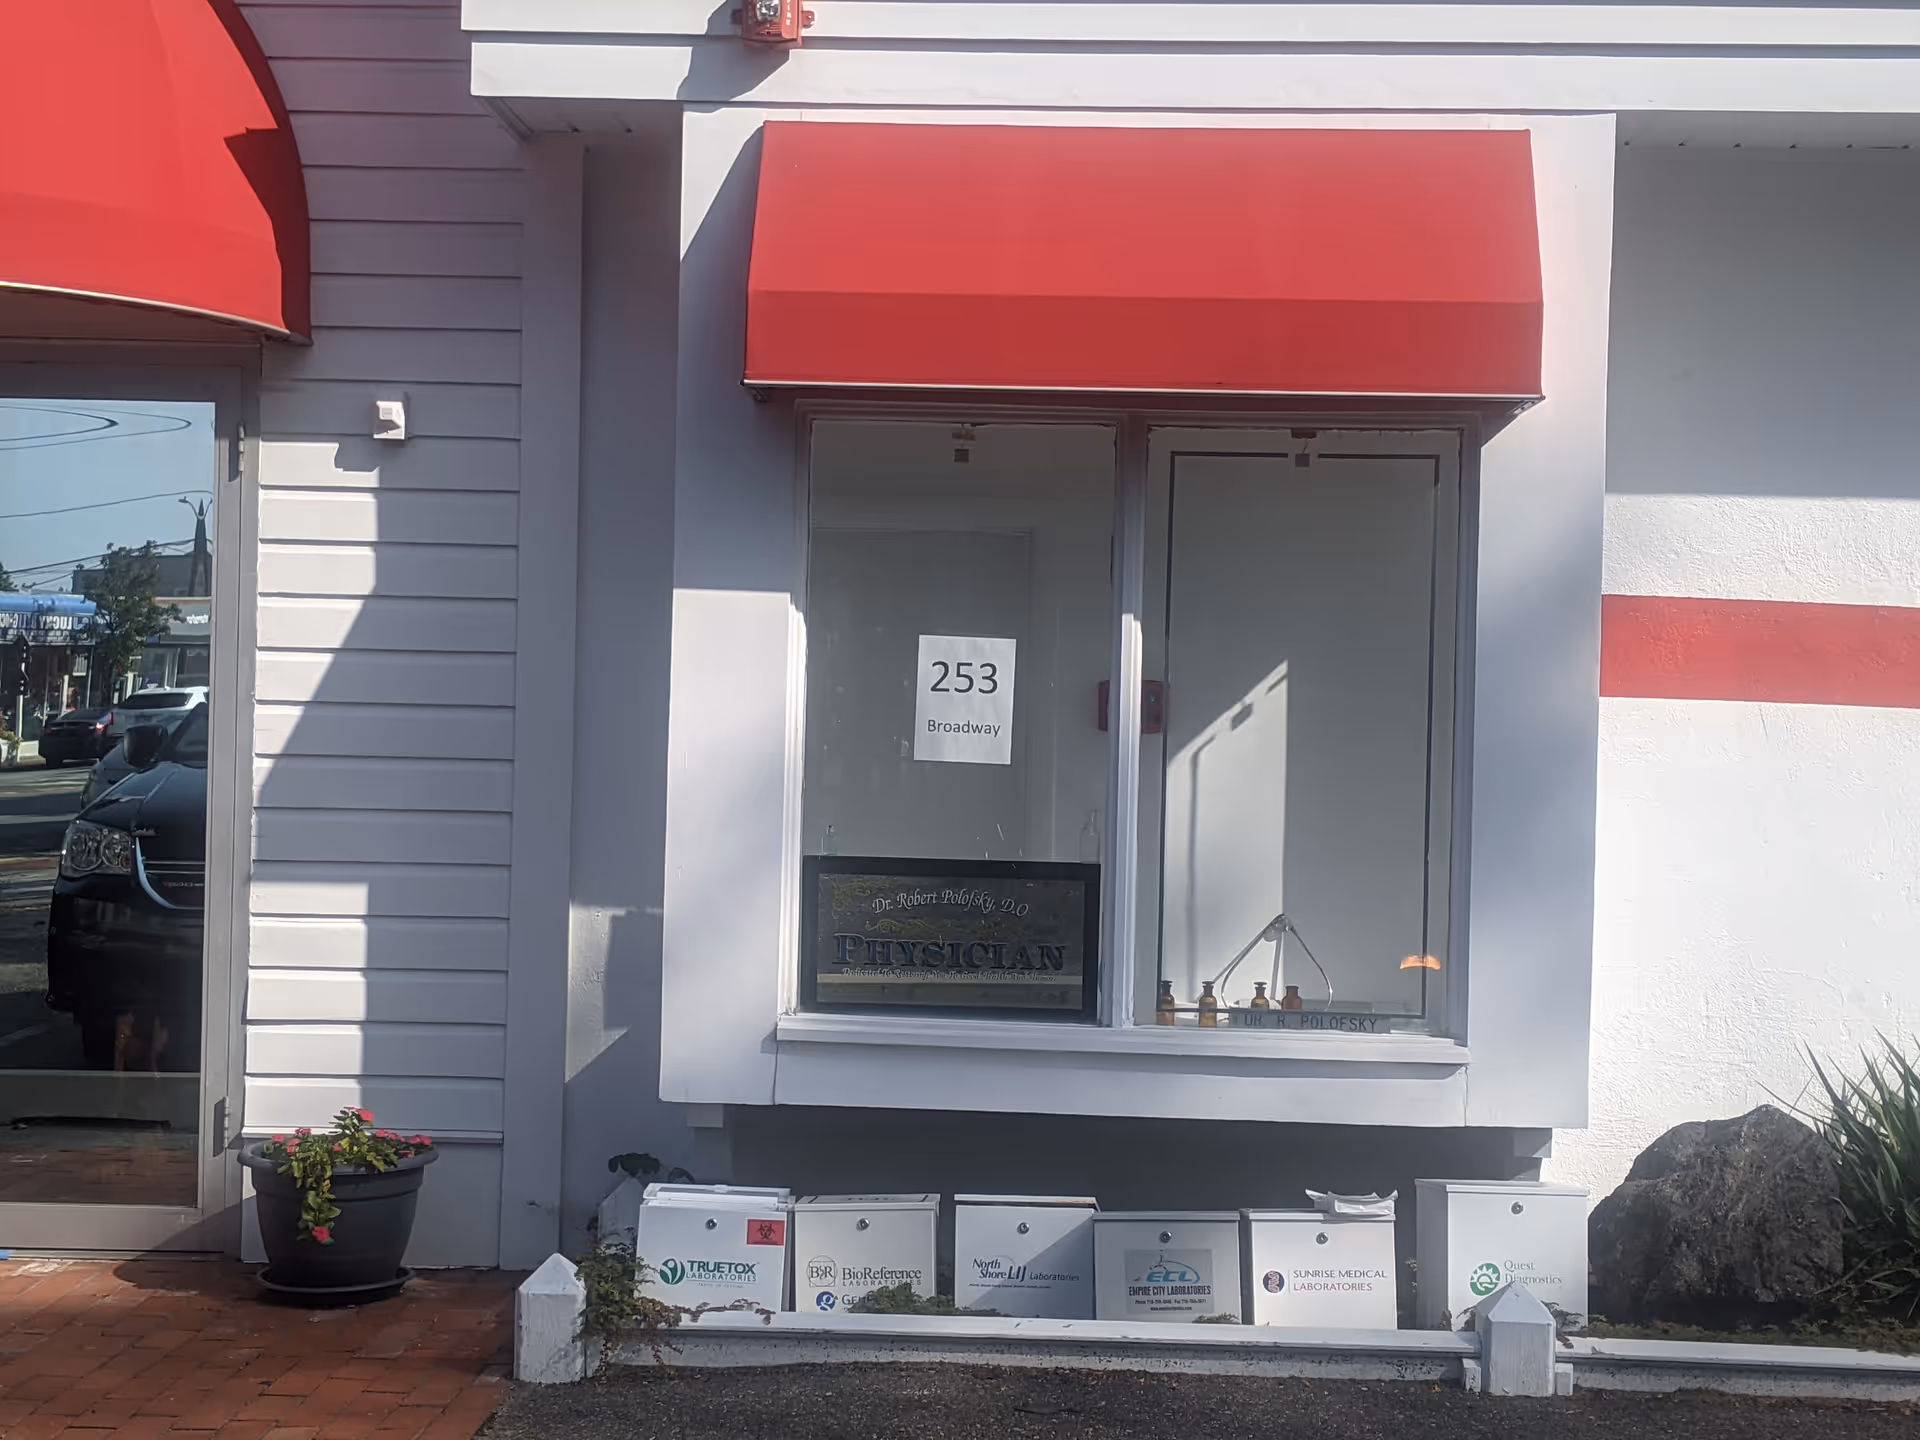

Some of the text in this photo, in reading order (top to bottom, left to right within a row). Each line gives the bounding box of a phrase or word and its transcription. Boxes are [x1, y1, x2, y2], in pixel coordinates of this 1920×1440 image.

[930, 660, 998, 694] 253
[927, 719, 1001, 738] Broadway
[872, 897, 894, 914] Dr.
[896, 888, 938, 910] Robert
[941, 888, 996, 914] Polofsky,
[831, 932, 1068, 972] PHYSICIAN
[1300, 1015, 1378, 1032] POLOFSKY
[687, 1259, 756, 1275] TRUETOX
[972, 1258, 1001, 1270] North
[1503, 1259, 1535, 1273] Quest
[686, 1272, 757, 1282] LABORATORIES
[842, 1266, 922, 1281] BioReference
[979, 1265, 1080, 1283] Shore LIJ Laboratories
[1146, 1271, 1193, 1283] ECL
[1293, 1269, 1388, 1279] SUNRISE MEDICAL
[1128, 1285, 1212, 1297] EMPIRE CITY LABORATORIES
[1293, 1282, 1373, 1292] LABORATORIES
